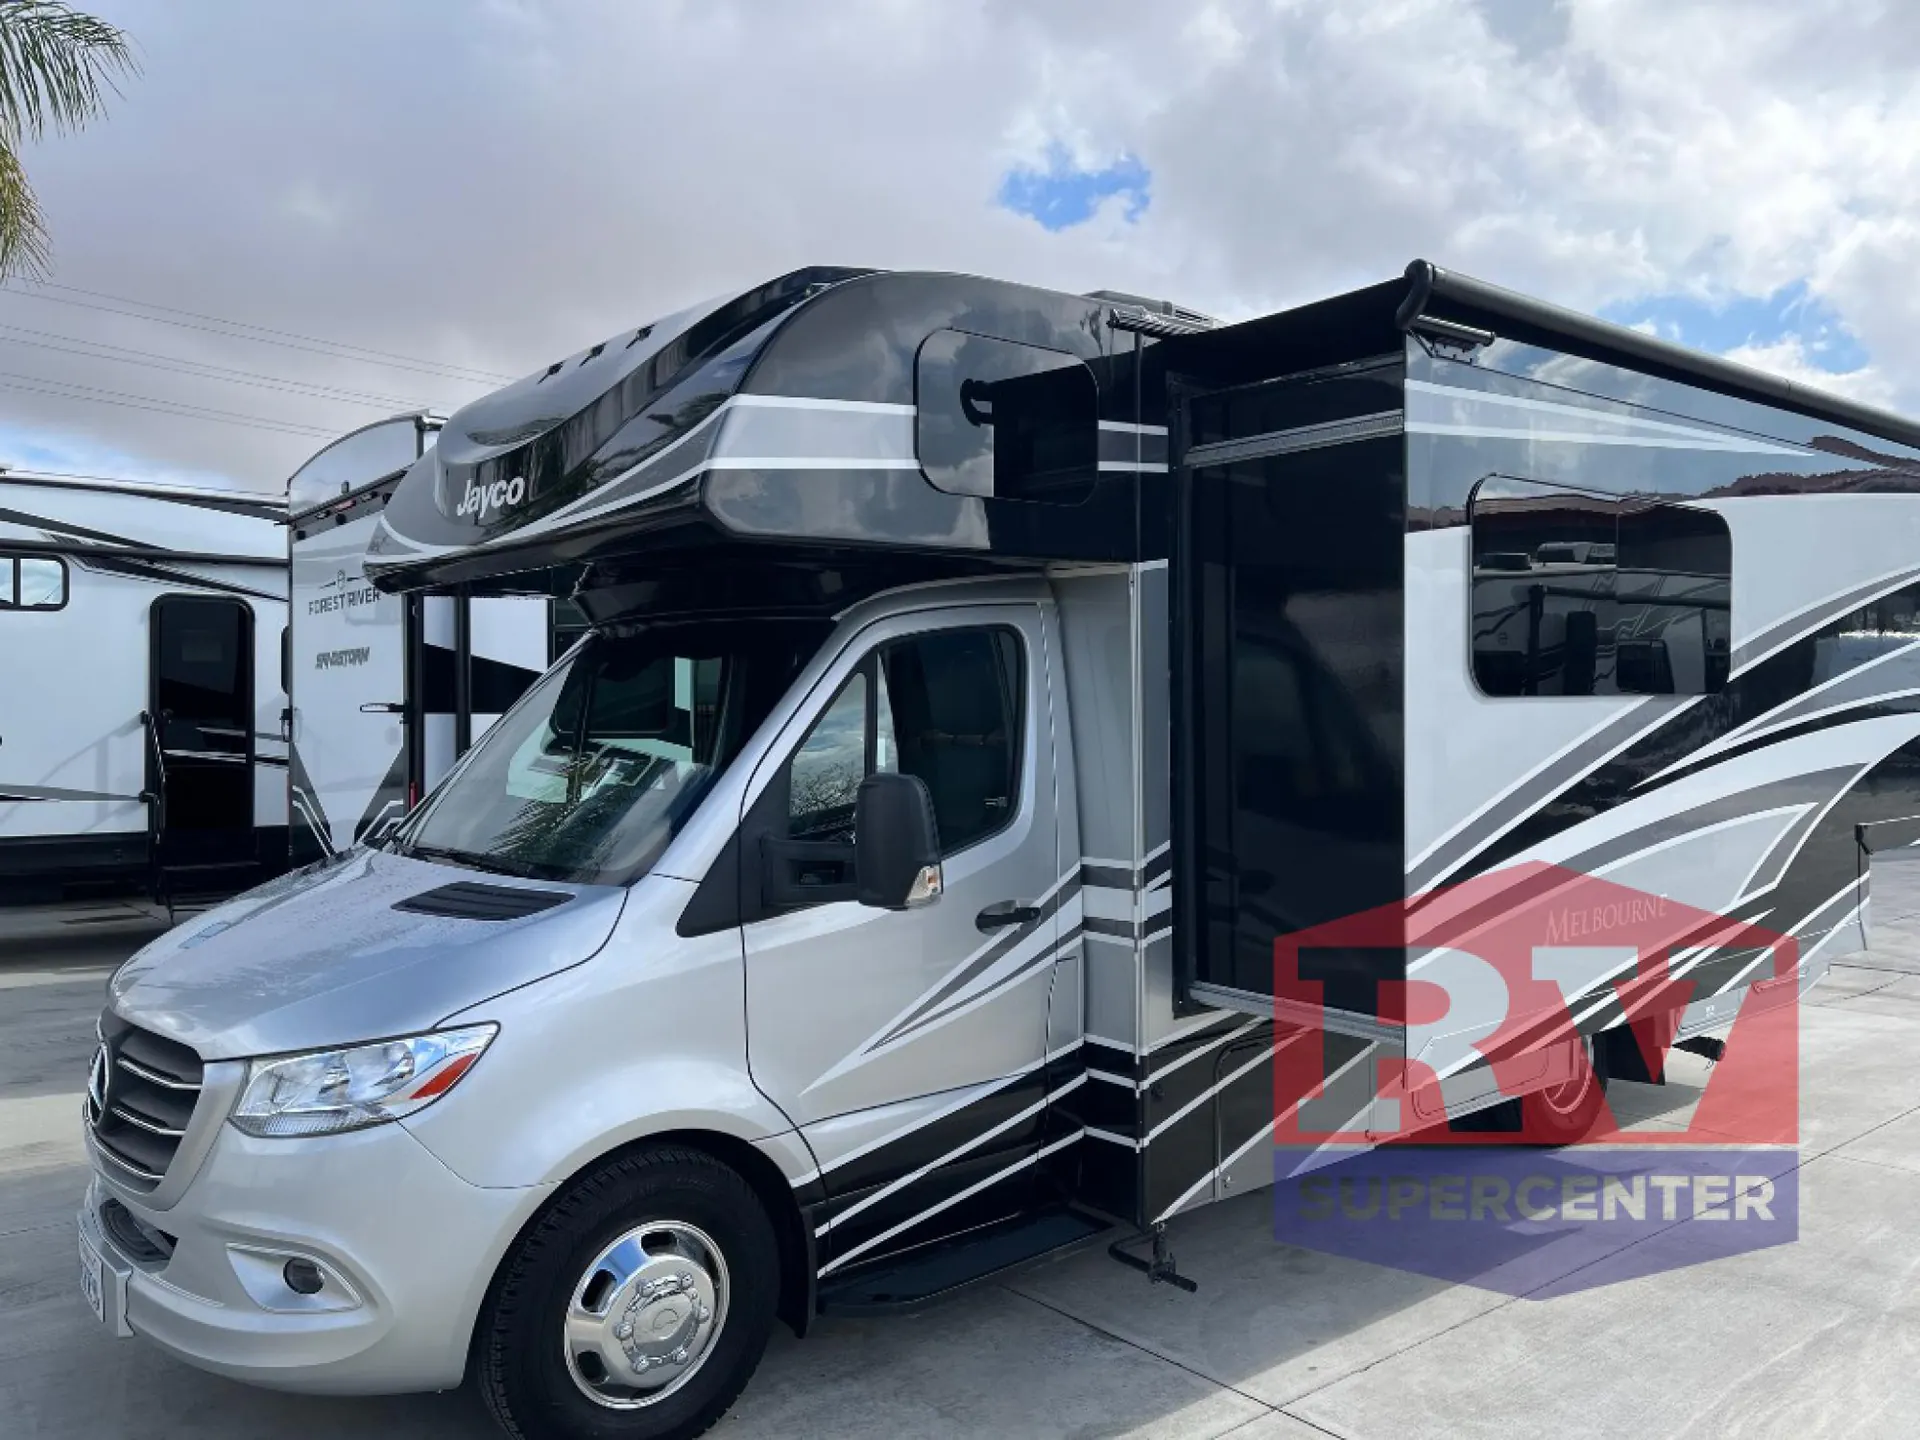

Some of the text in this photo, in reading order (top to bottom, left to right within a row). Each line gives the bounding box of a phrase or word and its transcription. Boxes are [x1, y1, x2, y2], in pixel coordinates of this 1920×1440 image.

[457, 476, 525, 518] Jayco
[308, 586, 381, 615] FOREST RIVER
